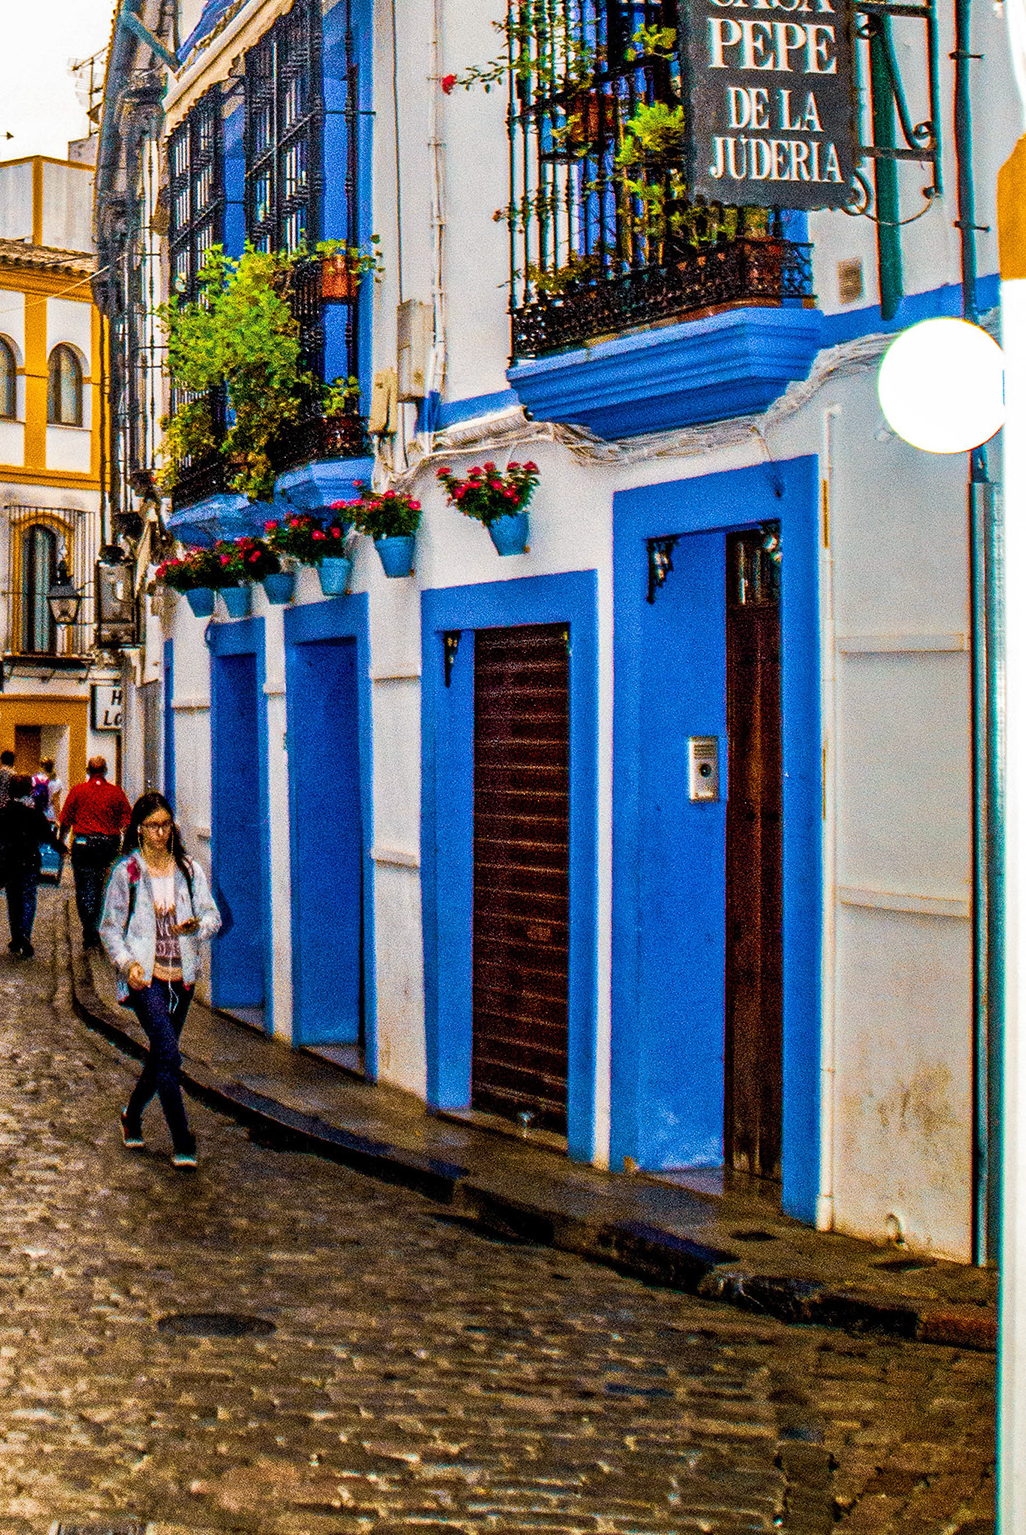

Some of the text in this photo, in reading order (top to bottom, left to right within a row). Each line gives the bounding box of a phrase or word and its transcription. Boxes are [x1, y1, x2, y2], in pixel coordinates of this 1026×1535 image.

[708, 17, 838, 75] PEPE
[727, 86, 824, 133] DE LA
